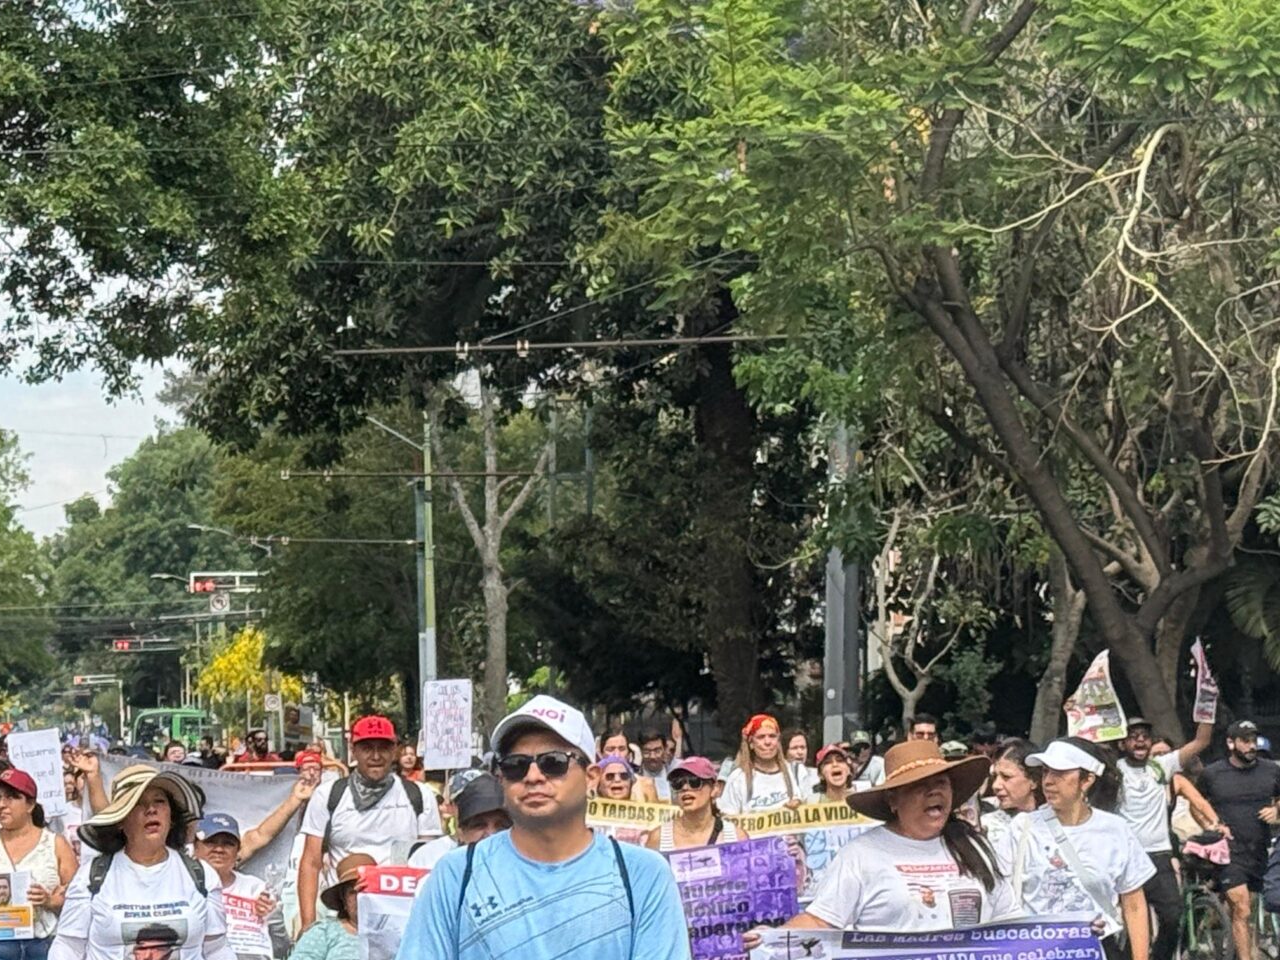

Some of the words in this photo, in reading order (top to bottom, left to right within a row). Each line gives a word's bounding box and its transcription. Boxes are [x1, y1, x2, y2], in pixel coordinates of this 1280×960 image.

[588, 801, 598, 816] O
[601, 802, 656, 822] TARDAS
[725, 814, 765, 832] PERO
[767, 810, 801, 828] TODA
[804, 807, 821, 823] LA
[823, 805, 860, 821] VIDA
[379, 874, 417, 894] DE
[850, 932, 887, 943] Las
[970, 926, 1092, 942] buscadoras
